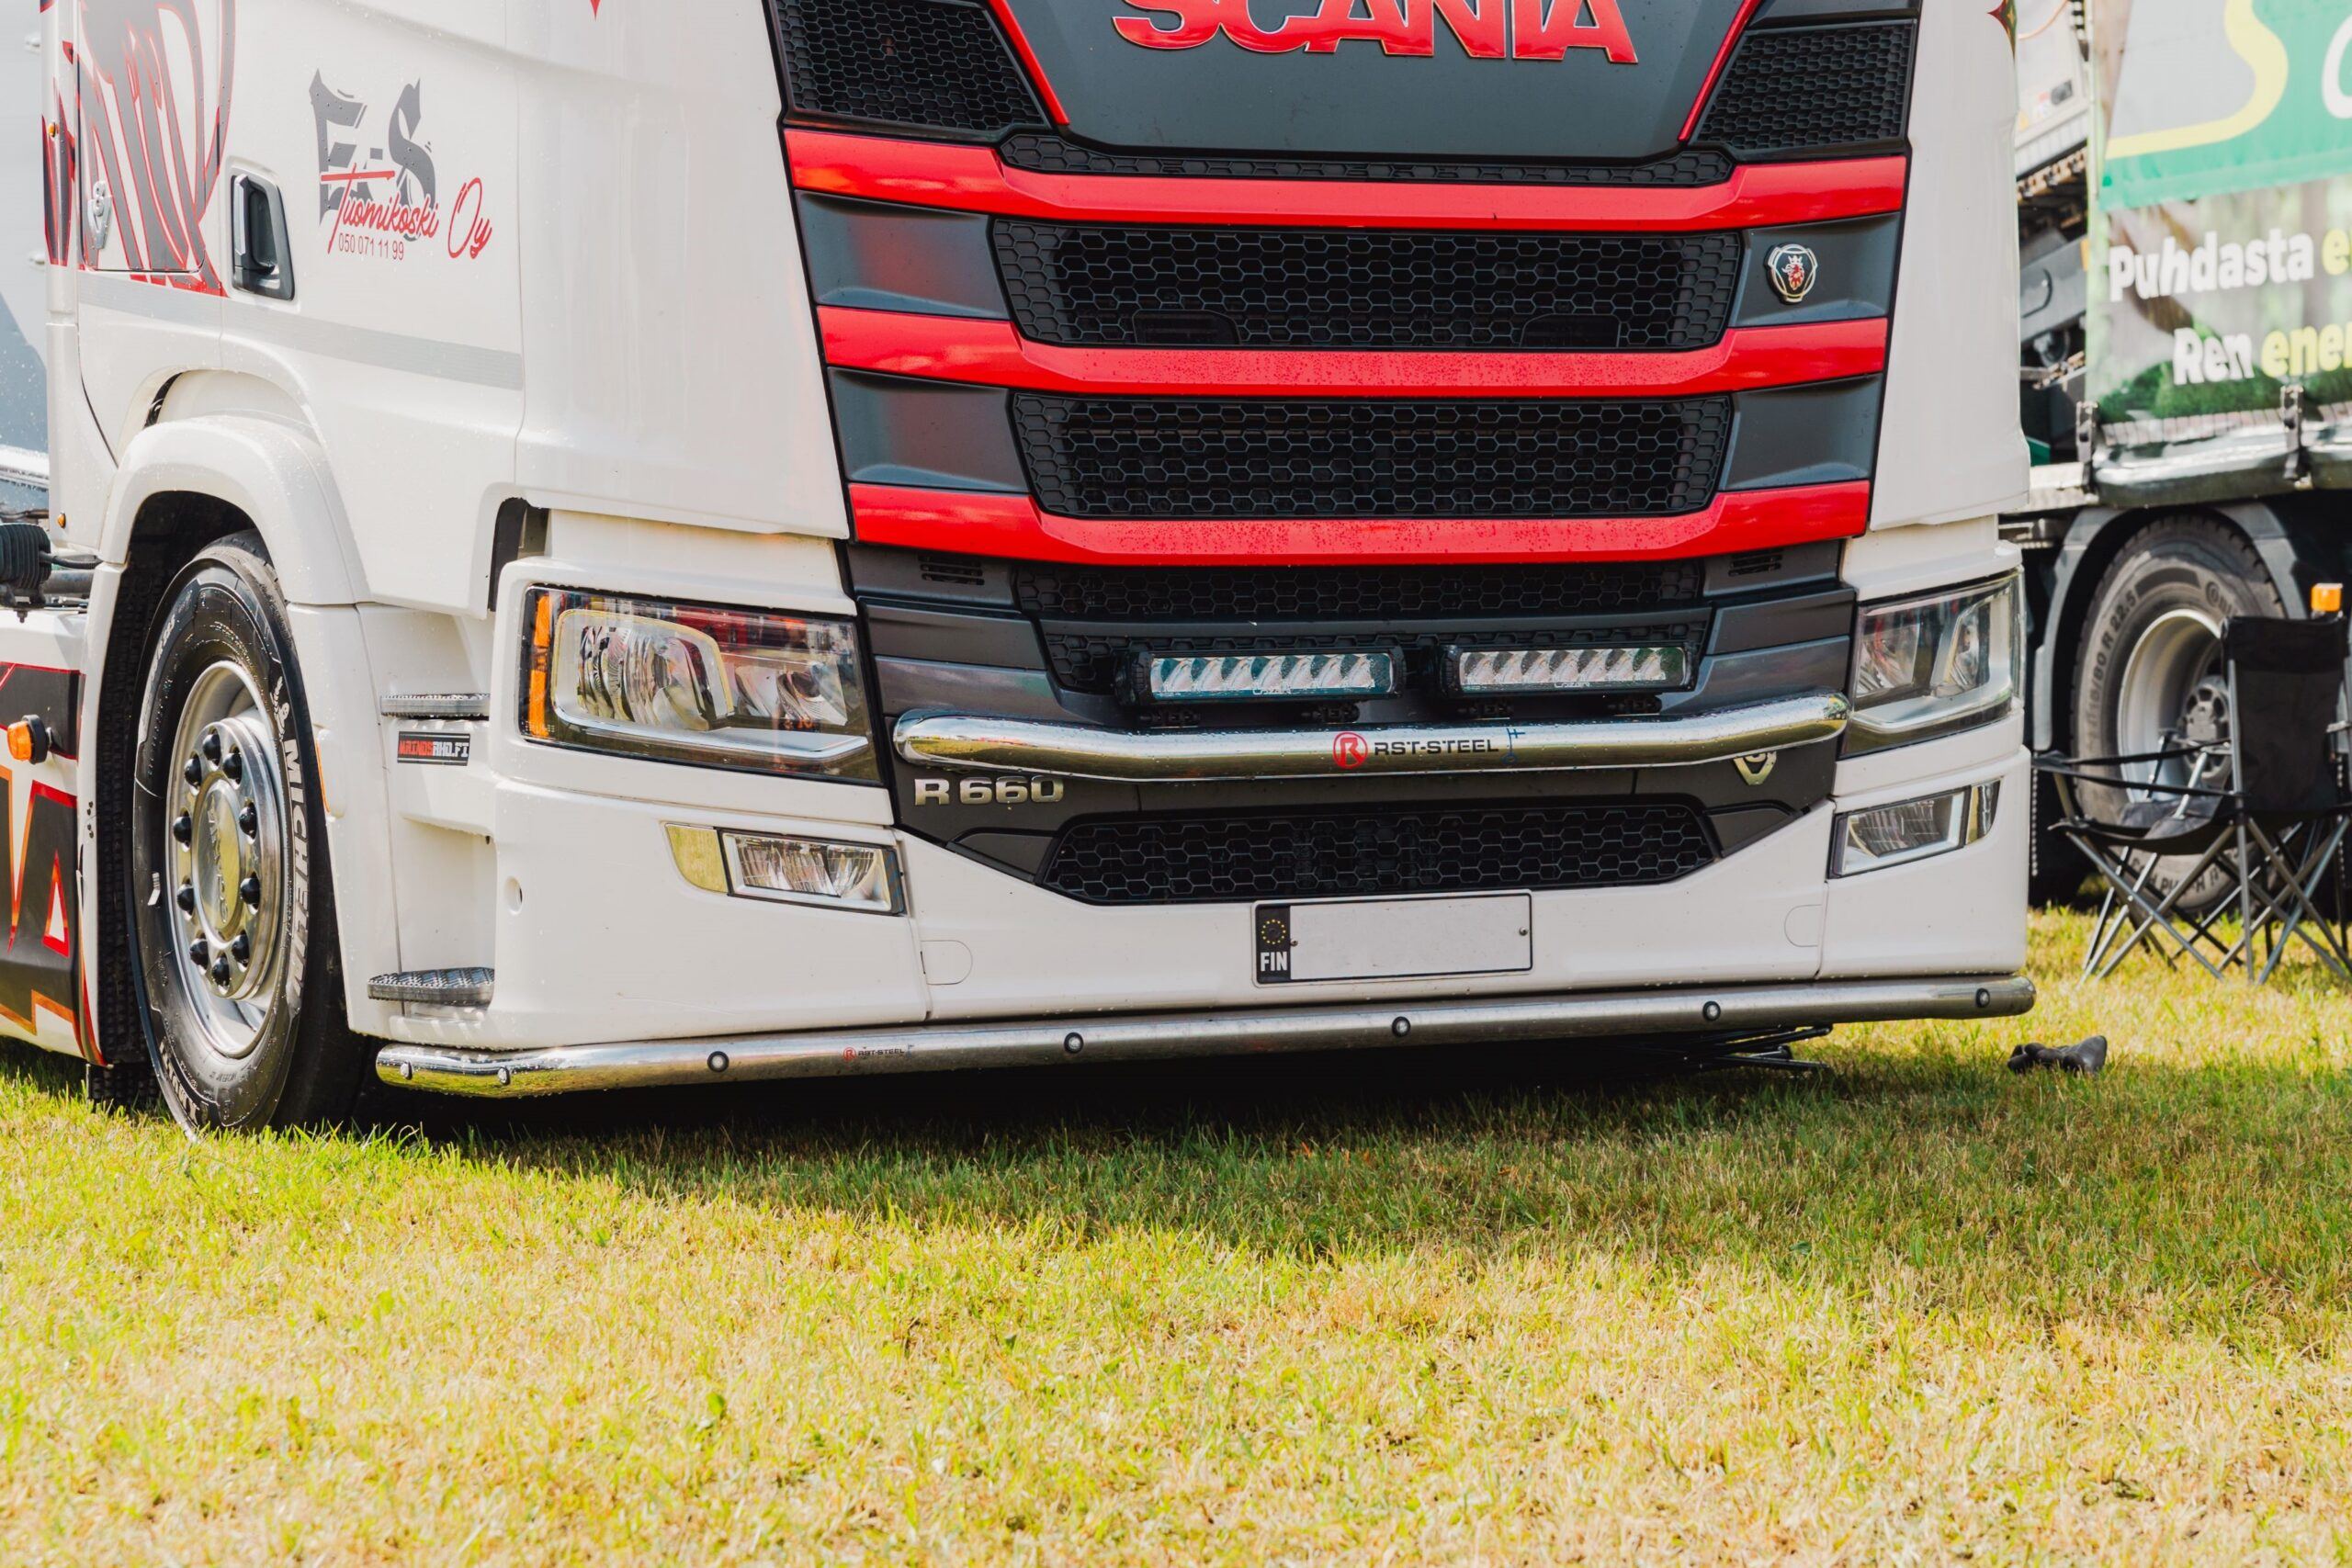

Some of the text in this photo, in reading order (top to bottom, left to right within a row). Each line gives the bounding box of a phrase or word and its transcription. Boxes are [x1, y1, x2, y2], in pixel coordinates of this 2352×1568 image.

[1113, 0, 1638, 63] SCANIA
[322, 163, 492, 259] Tuomikoski Oy
[338, 232, 404, 260] 050 071 11 99
[2109, 228, 2352, 301] Puhdasta e
[2173, 326, 2255, 386] Ren
[1374, 739, 1499, 756] RST-STEEL
[959, 775, 1065, 805] 660
[282, 738, 310, 998] MICHELIN
[1260, 952, 1287, 971] FIN
